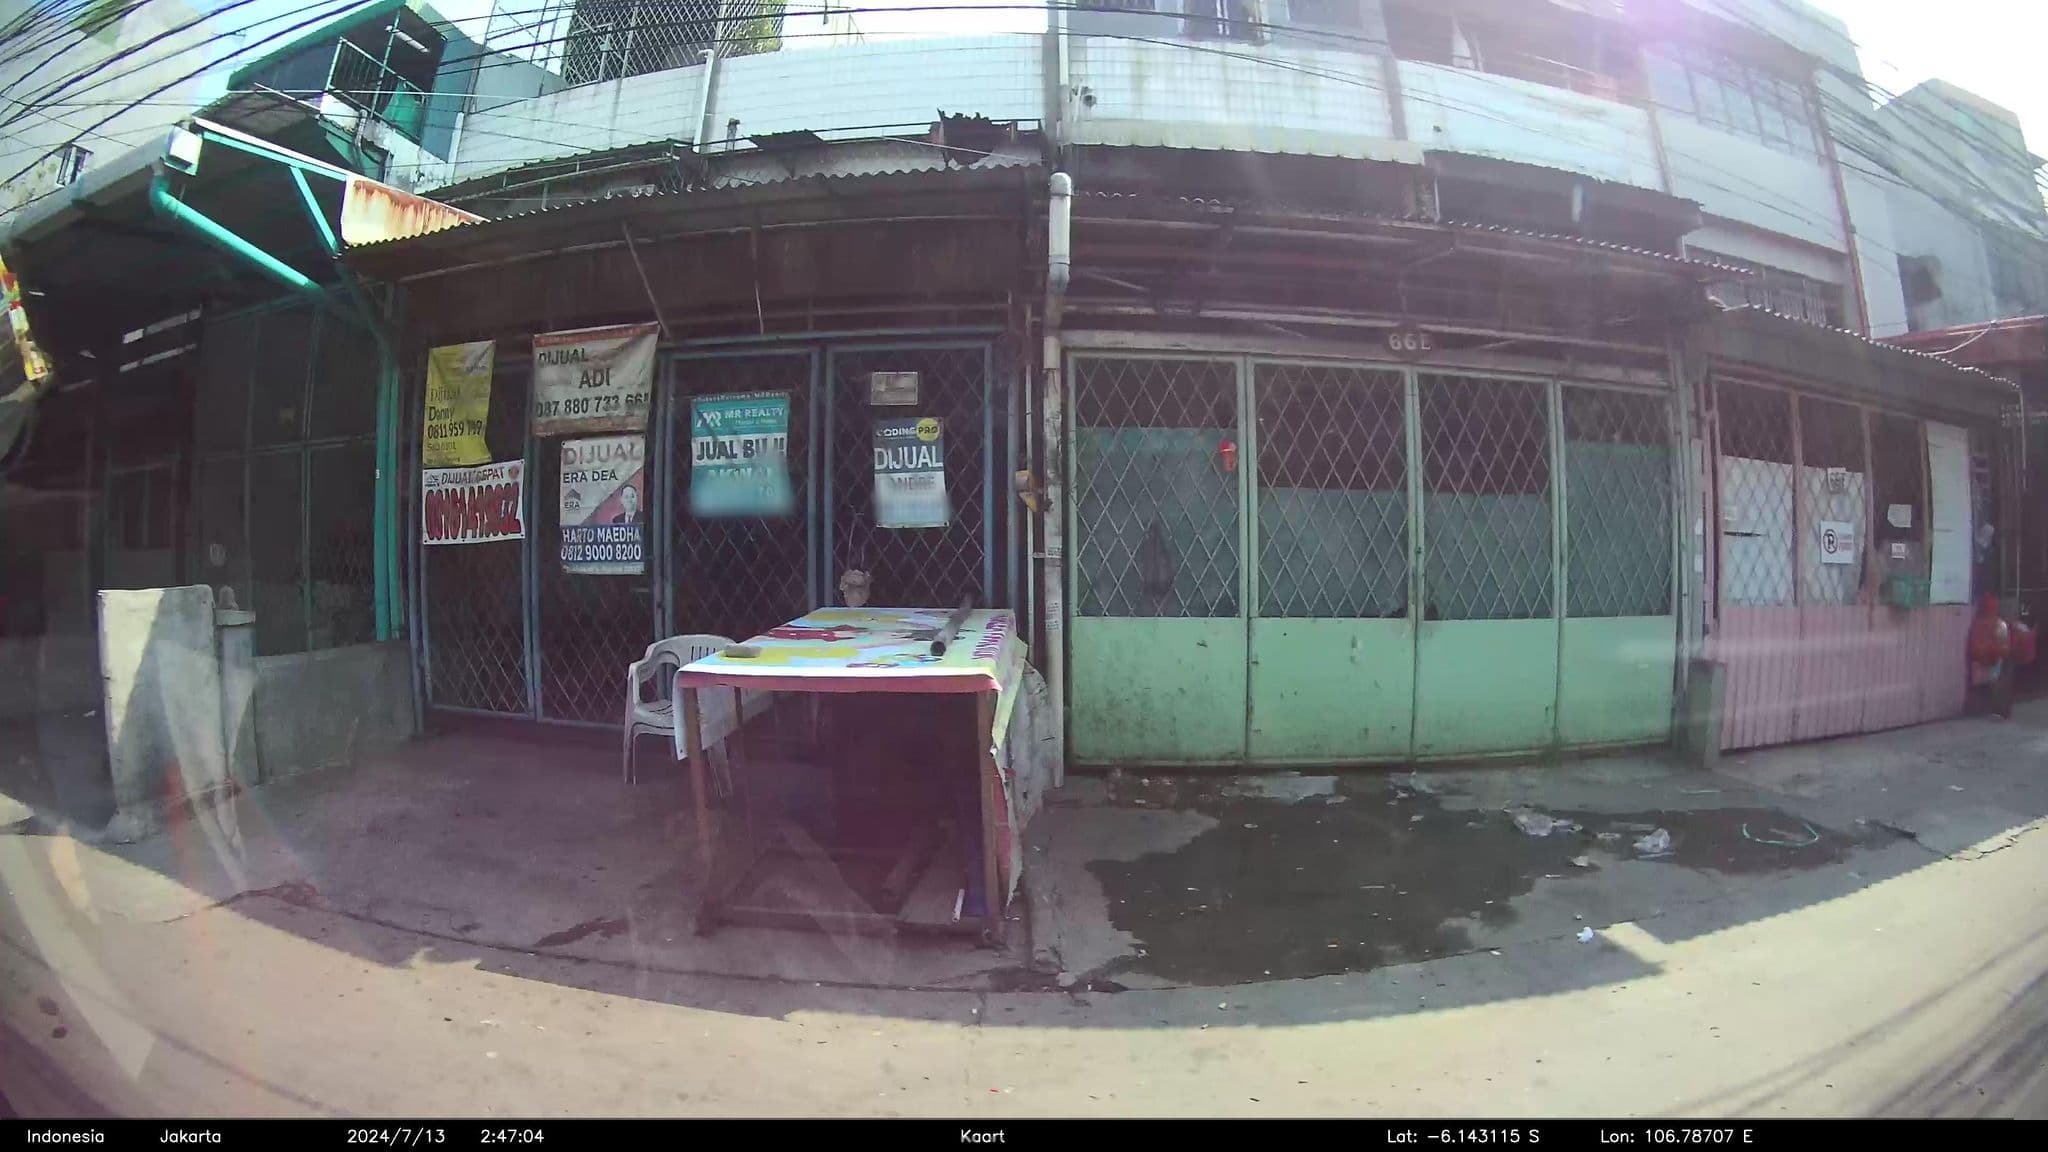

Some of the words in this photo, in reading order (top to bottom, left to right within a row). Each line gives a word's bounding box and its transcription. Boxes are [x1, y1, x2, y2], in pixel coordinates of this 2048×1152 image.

[538, 347, 588, 367] DIJUAL
[578, 367, 611, 389] ADI
[535, 400, 560, 418] 087
[564, 397, 589, 415] 880
[561, 442, 641, 466] DIJUAL
[696, 440, 738, 461] JUAL
[873, 445, 944, 470] DIJUAL
[562, 472, 588, 484] ERA
[592, 469, 618, 482] DEA
[564, 501, 580, 510] ERA
[597, 527, 641, 543] MAEDHA
[560, 544, 583, 562] 0812
[585, 543, 613, 561] 9000
[615, 543, 642, 561] 8200
